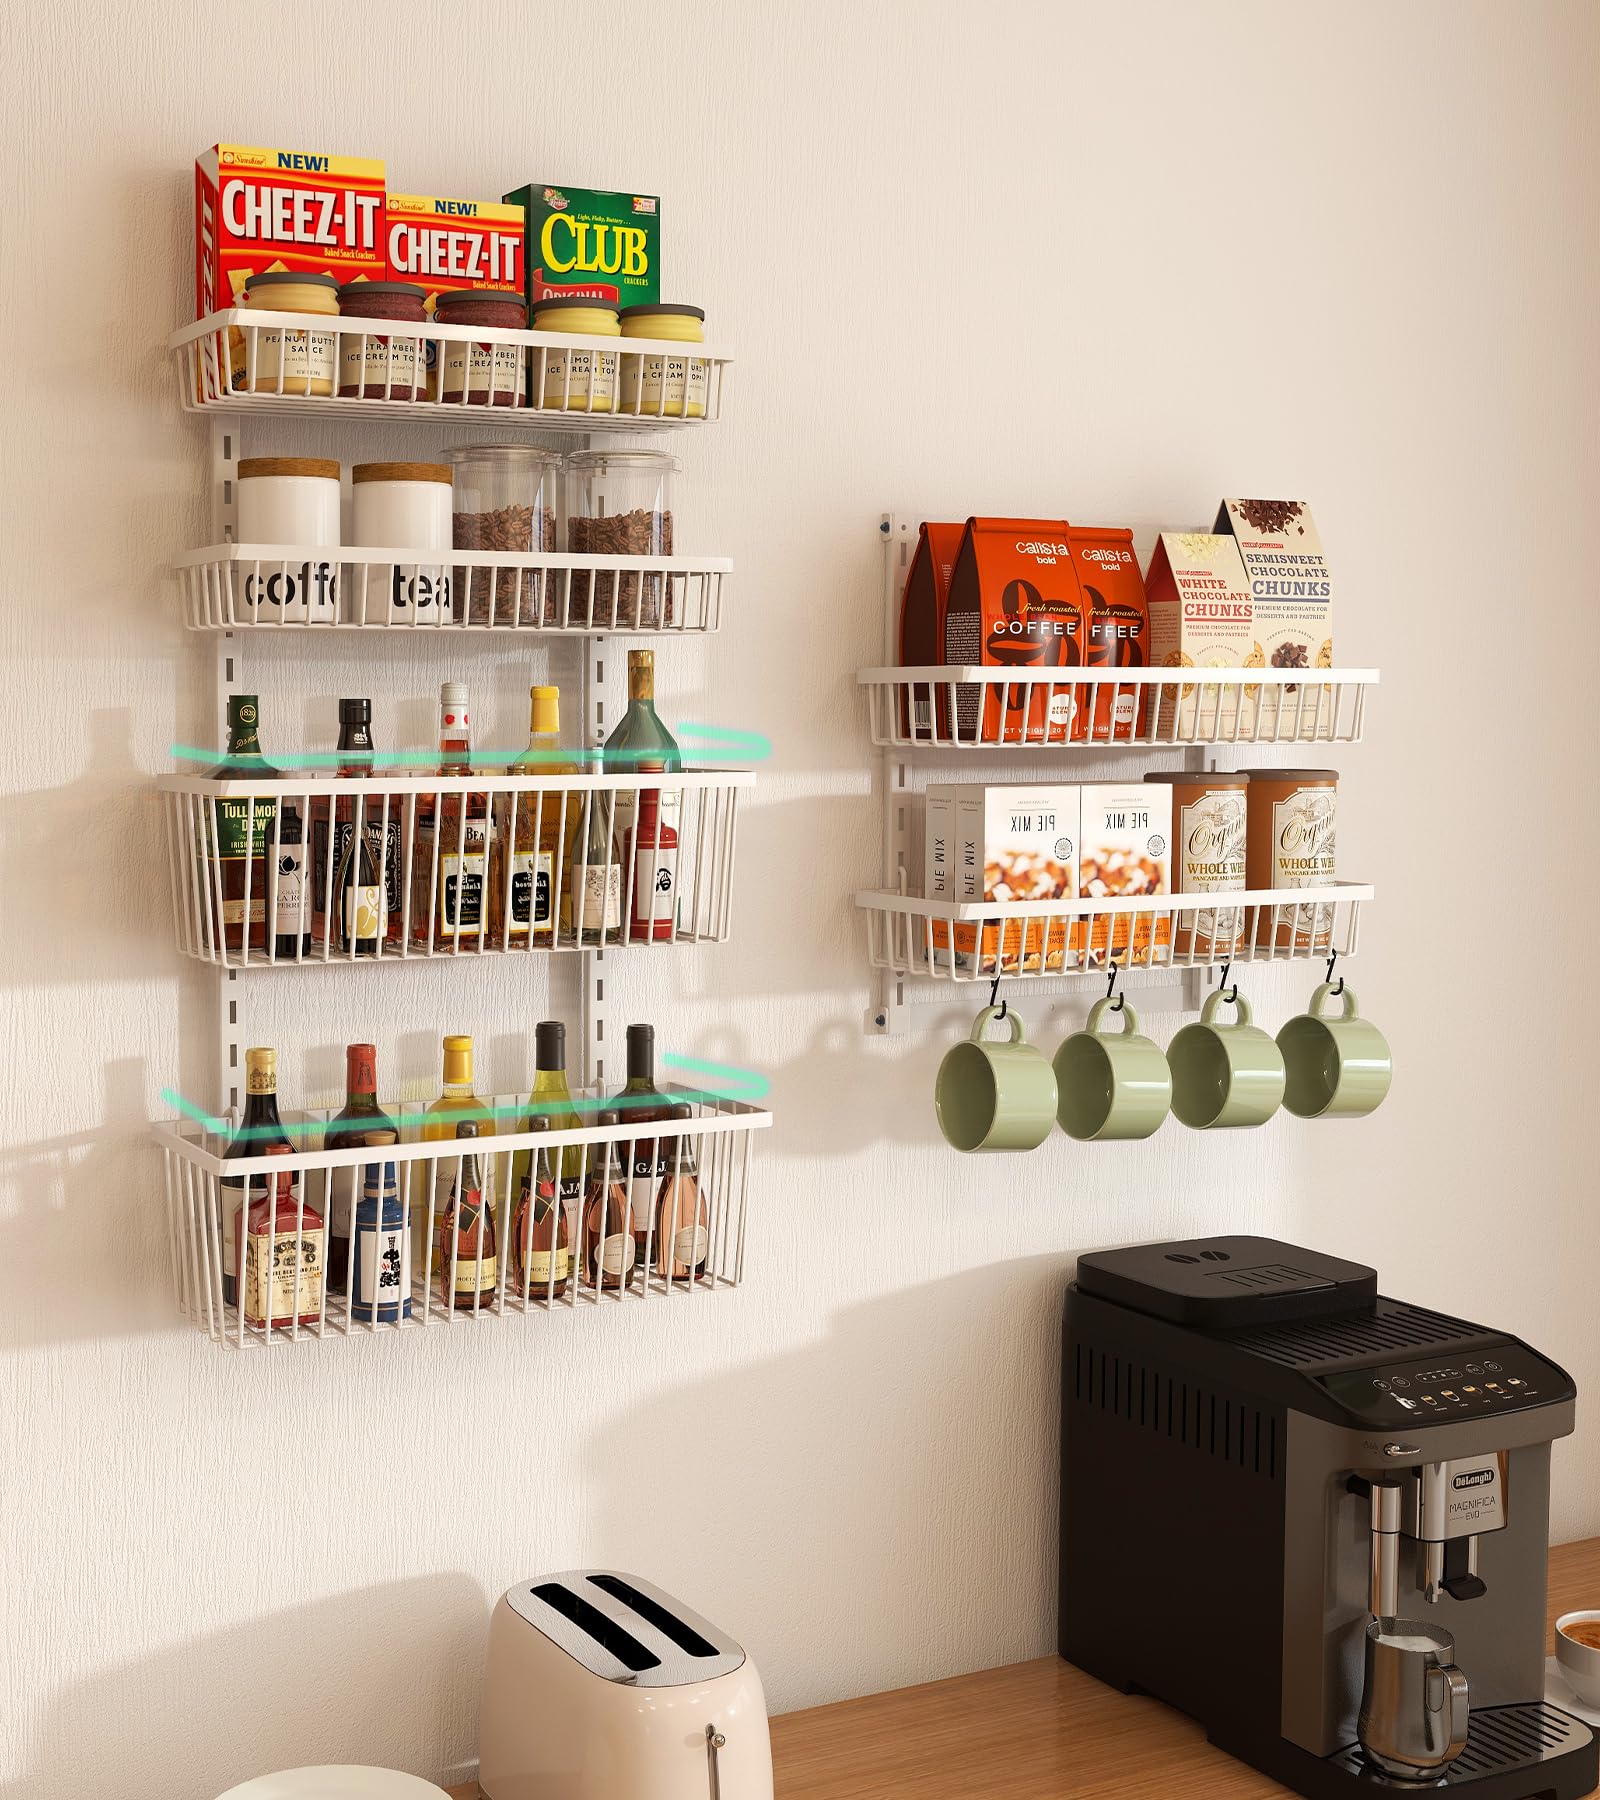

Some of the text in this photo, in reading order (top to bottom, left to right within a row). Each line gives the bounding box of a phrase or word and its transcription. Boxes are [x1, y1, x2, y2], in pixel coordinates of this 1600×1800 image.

[278, 152, 329, 172] NEW!
[222, 179, 381, 248] CHEEZ-IT
[435, 200, 477, 216] NEW!
[541, 212, 648, 276] CLUB
[324, 248, 376, 260] Baked Snack Crackers
[388, 223, 520, 280] CHEEZ-IT
[624, 277, 648, 286] CRACKERS
[292, 346, 323, 354] SACE
[472, 350, 515, 359] TRABER
[348, 354, 360, 362] ICE
[1036, 556, 1057, 565] bold
[1246, 554, 1324, 565] SEMISWEET
[1101, 562, 1120, 571] bold
[1250, 566, 1329, 578] CHOCOLATE
[392, 564, 450, 608] tea
[1178, 578, 1227, 589] WHITE
[1252, 580, 1330, 596] CHUNKS
[1182, 592, 1252, 601] CHOCOLATE
[1016, 602, 1081, 614] fresh roasted
[1088, 608, 1143, 618] fresh roasted
[1184, 604, 1253, 617] CHUNKS
[993, 620, 1076, 636] COFFEE
[222, 802, 276, 818] TULLMOR
[1187, 862, 1228, 874] WHOLE
[1280, 858, 1319, 869] WHOLE
[636, 1160, 668, 1174] GAJ
[559, 1182, 581, 1196] AJA
[1450, 1495, 1496, 1514] MAGNIFICA
[1466, 1510, 1480, 1520] EVO
